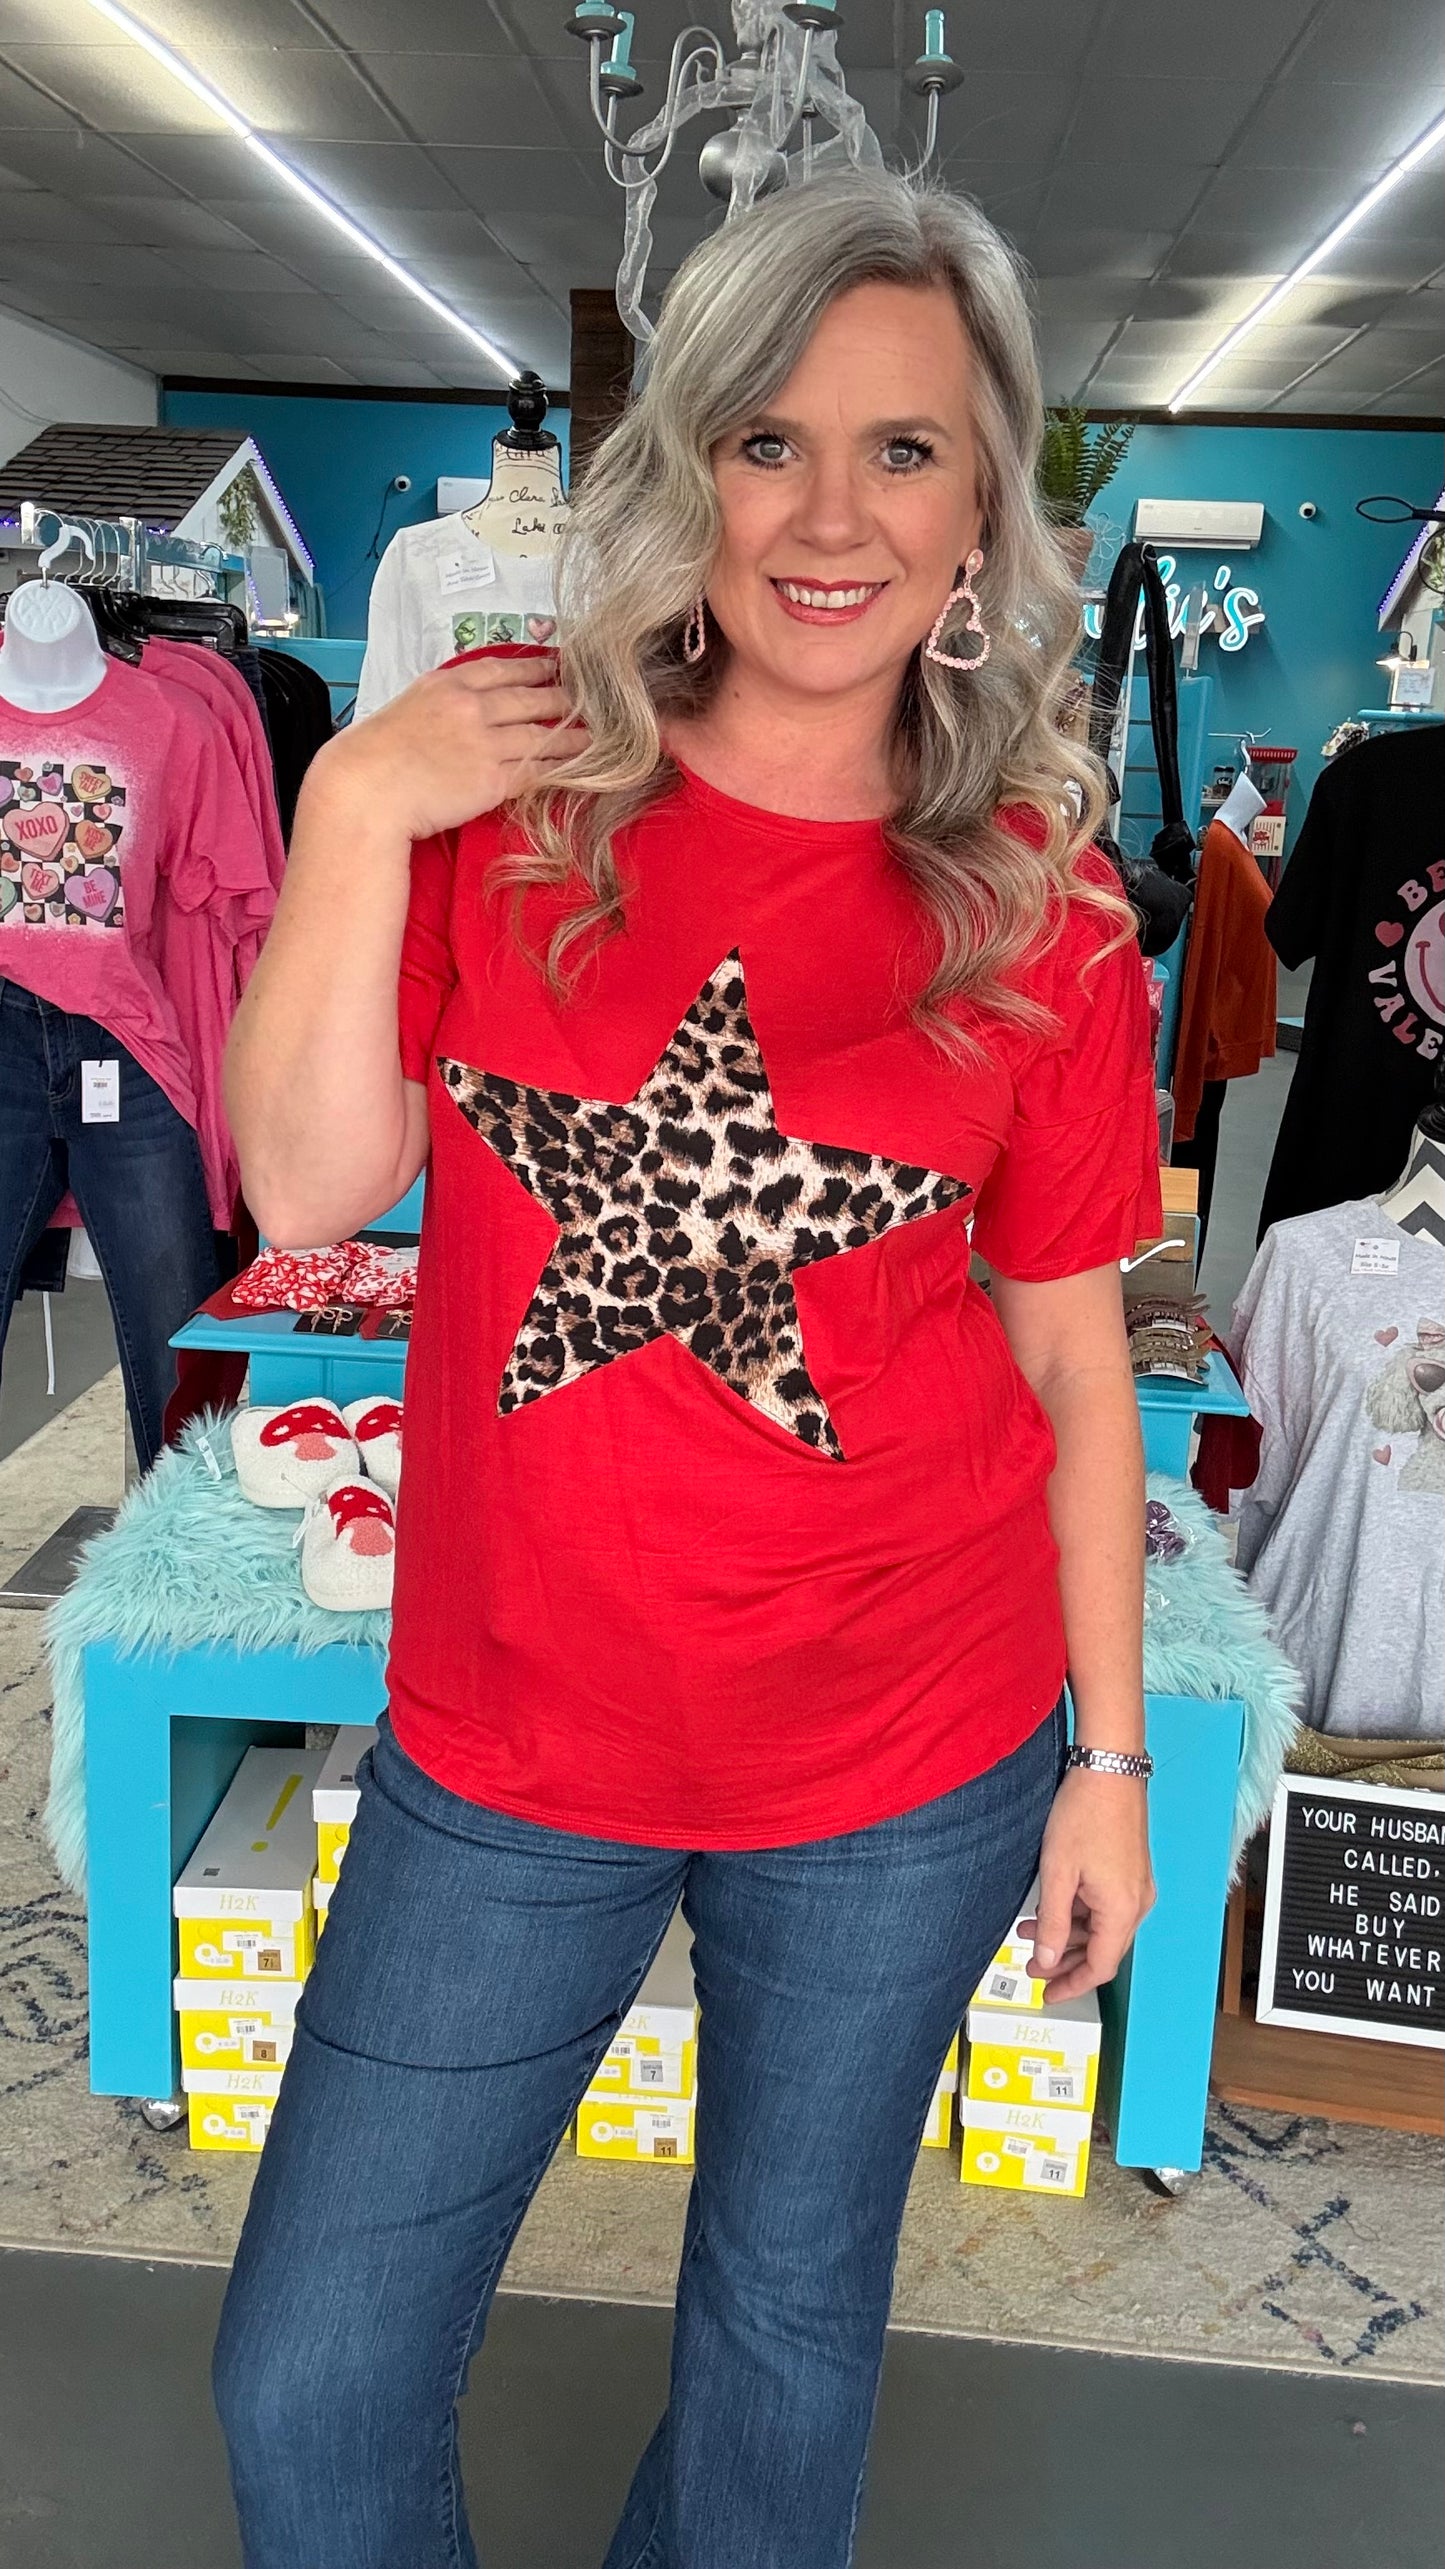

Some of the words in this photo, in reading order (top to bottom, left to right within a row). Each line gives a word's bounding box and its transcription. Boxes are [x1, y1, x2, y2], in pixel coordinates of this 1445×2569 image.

[79, 771, 105, 788] SWEET
[79, 780, 97, 794] TALK
[15, 815, 58, 841] XOXO
[30, 868, 53, 886] TEXT
[30, 878, 44, 893] ME
[83, 879, 97, 894] BE
[83, 891, 107, 909] MINE
[1301, 1806, 1356, 1834] YOUR
[1344, 1849, 1440, 1879] CALLED,
[219, 1893, 257, 1911] H2K
[1329, 1883, 1359, 1907] HE
[1389, 1891, 1441, 1917] SAID
[1355, 1913, 1405, 1939] BUY
[1307, 1934, 1441, 1973] WHATEVER
[999, 1980, 1007, 1991] 8
[1292, 1968, 1335, 1994] YOU
[1366, 1978, 1436, 2008] WANT
[219, 1989, 257, 2007] H2K
[626, 2014, 648, 2030] 2K
[1014, 2024, 1055, 2044] H2K
[260, 2049, 268, 2059] 8
[226, 2072, 264, 2090] H2K
[650, 2070, 657, 2081] 7
[1056, 2086, 1067, 2096] 11
[1005, 2109, 1046, 2130] H2K
[661, 2146, 672, 2156] 11
[1049, 2169, 1060, 2180] 11
